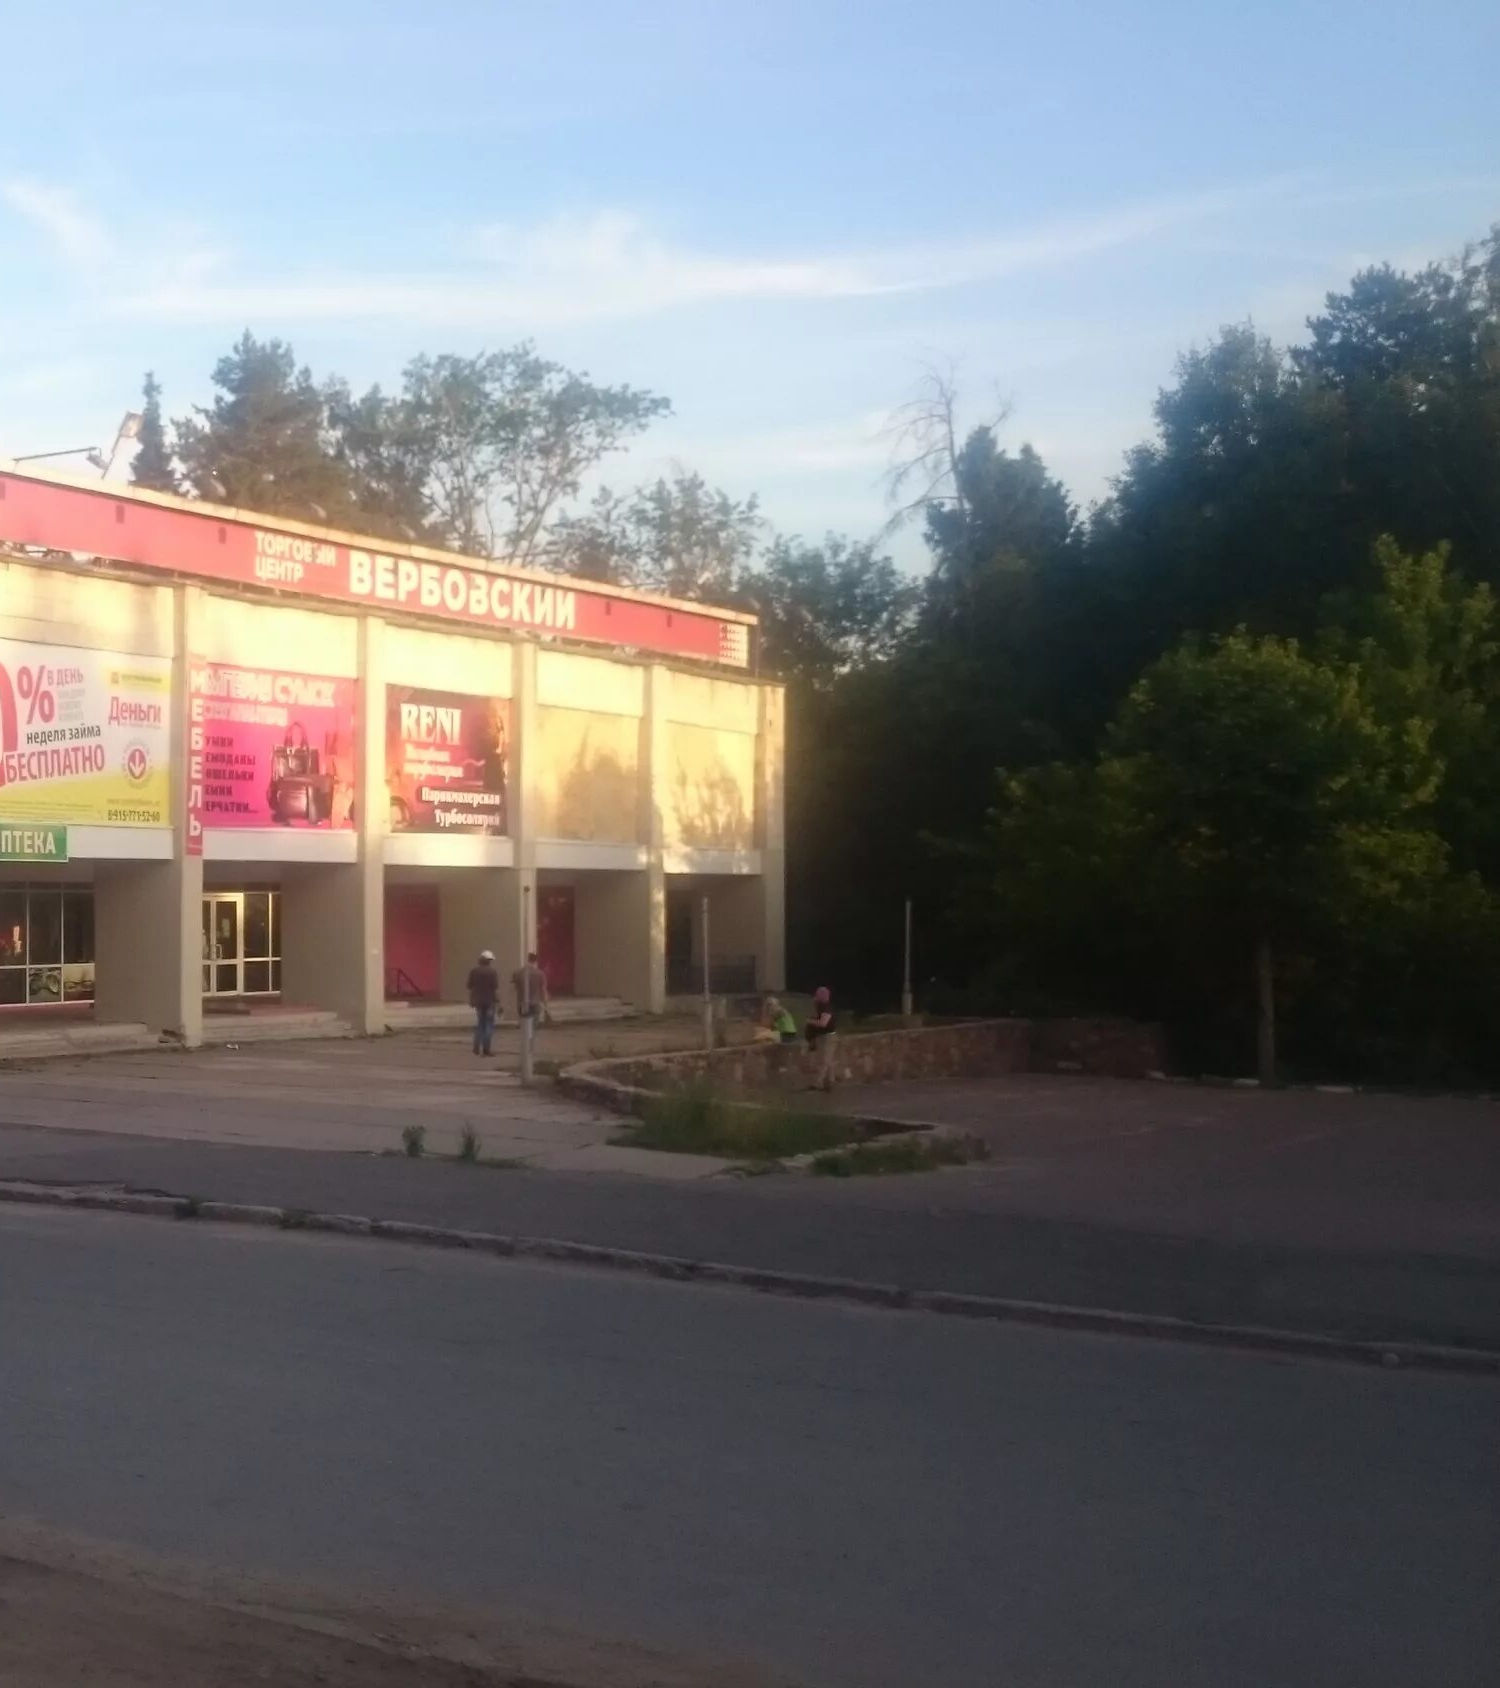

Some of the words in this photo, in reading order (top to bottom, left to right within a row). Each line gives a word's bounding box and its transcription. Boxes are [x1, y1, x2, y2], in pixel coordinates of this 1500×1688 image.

[255, 555, 304, 584] ЦЕНТР
[56, 668, 84, 687] ДЕНЬ
[108, 696, 161, 727] Деньги
[400, 702, 462, 745] RENI
[26, 728, 66, 746] неделя
[67, 722, 102, 741] займа
[5, 744, 106, 784] БЕСПЛАТНО
[188, 669, 205, 837] МЕБЕЛЬ
[205, 752, 256, 766] ЕМОДАНЫ
